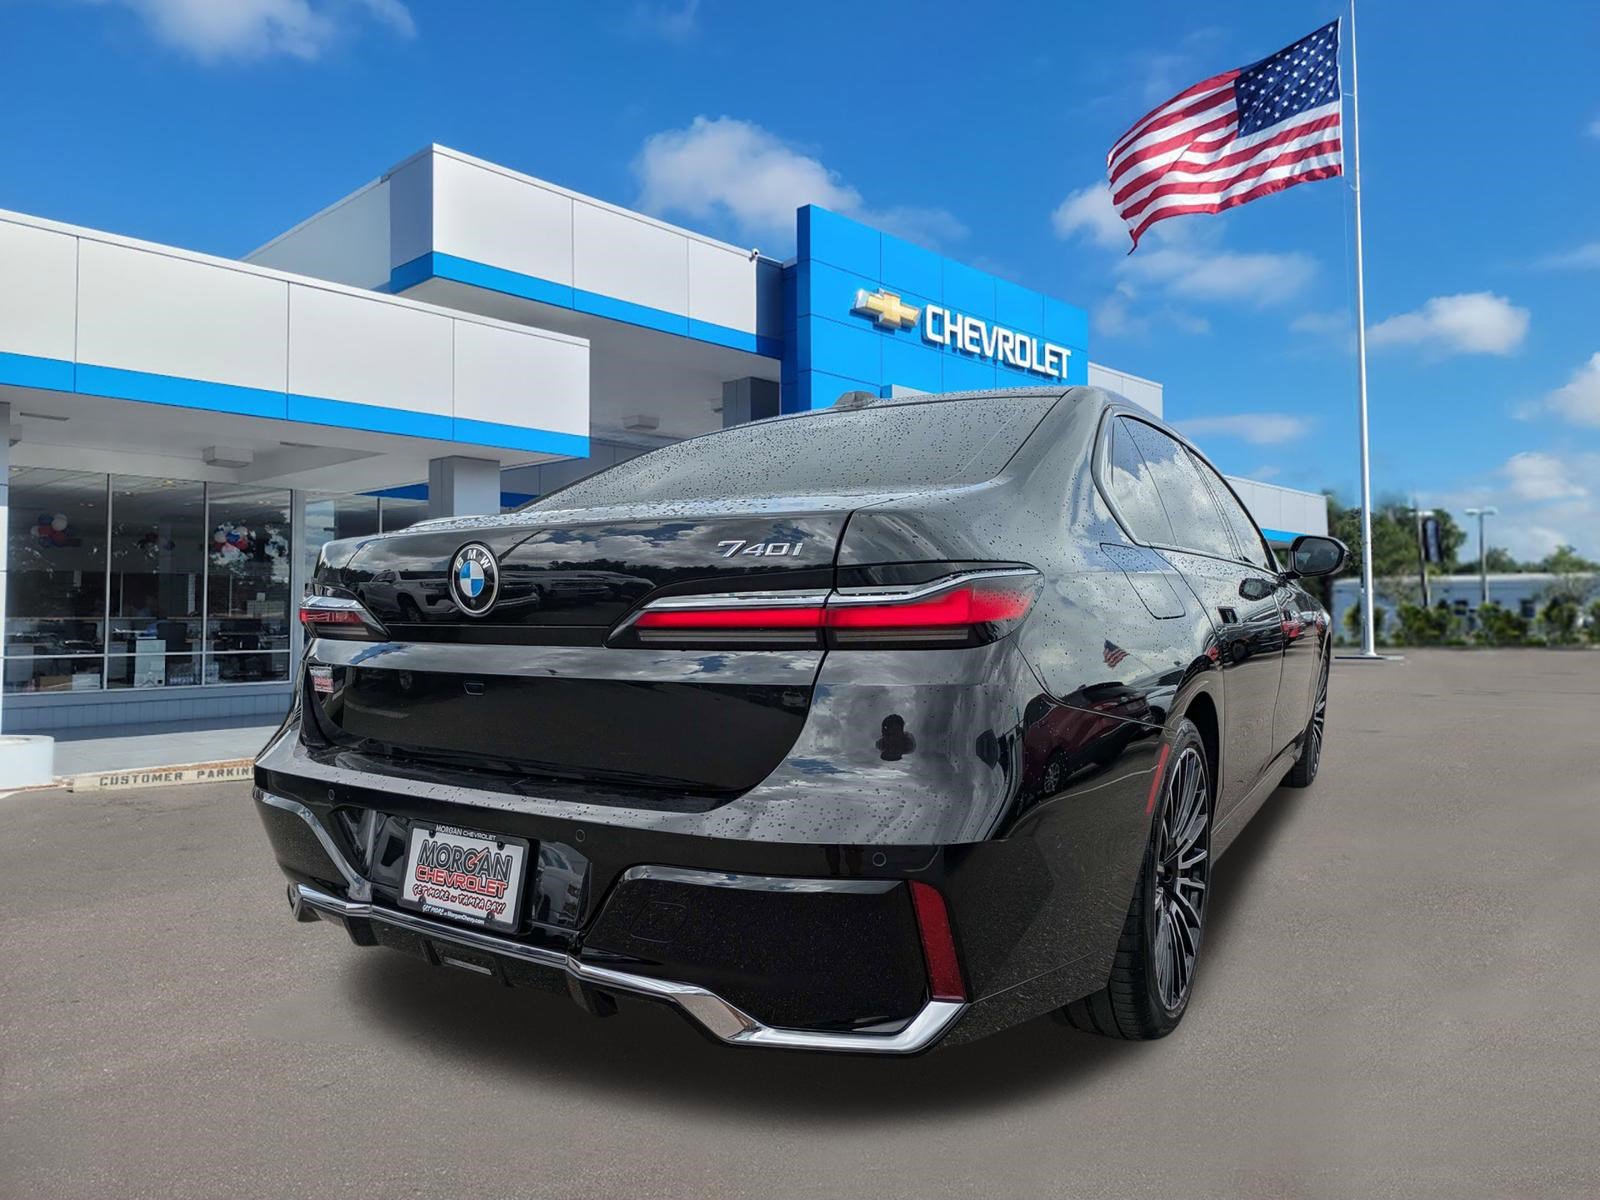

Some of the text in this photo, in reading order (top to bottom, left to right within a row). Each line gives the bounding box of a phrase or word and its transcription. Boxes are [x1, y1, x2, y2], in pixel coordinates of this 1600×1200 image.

[926, 304, 1072, 379] CHEVROLET
[456, 549, 491, 569] BMW
[100, 772, 183, 786] CUSTOMER
[436, 824, 497, 840] MORGAN CHEVROLET
[417, 839, 513, 883] MORGAN
[415, 865, 507, 899] CHEVROLET
[412, 883, 427, 897] GET
[426, 887, 450, 902] MORE
[458, 893, 485, 910] TAMPA
[485, 899, 507, 915] BAY!
